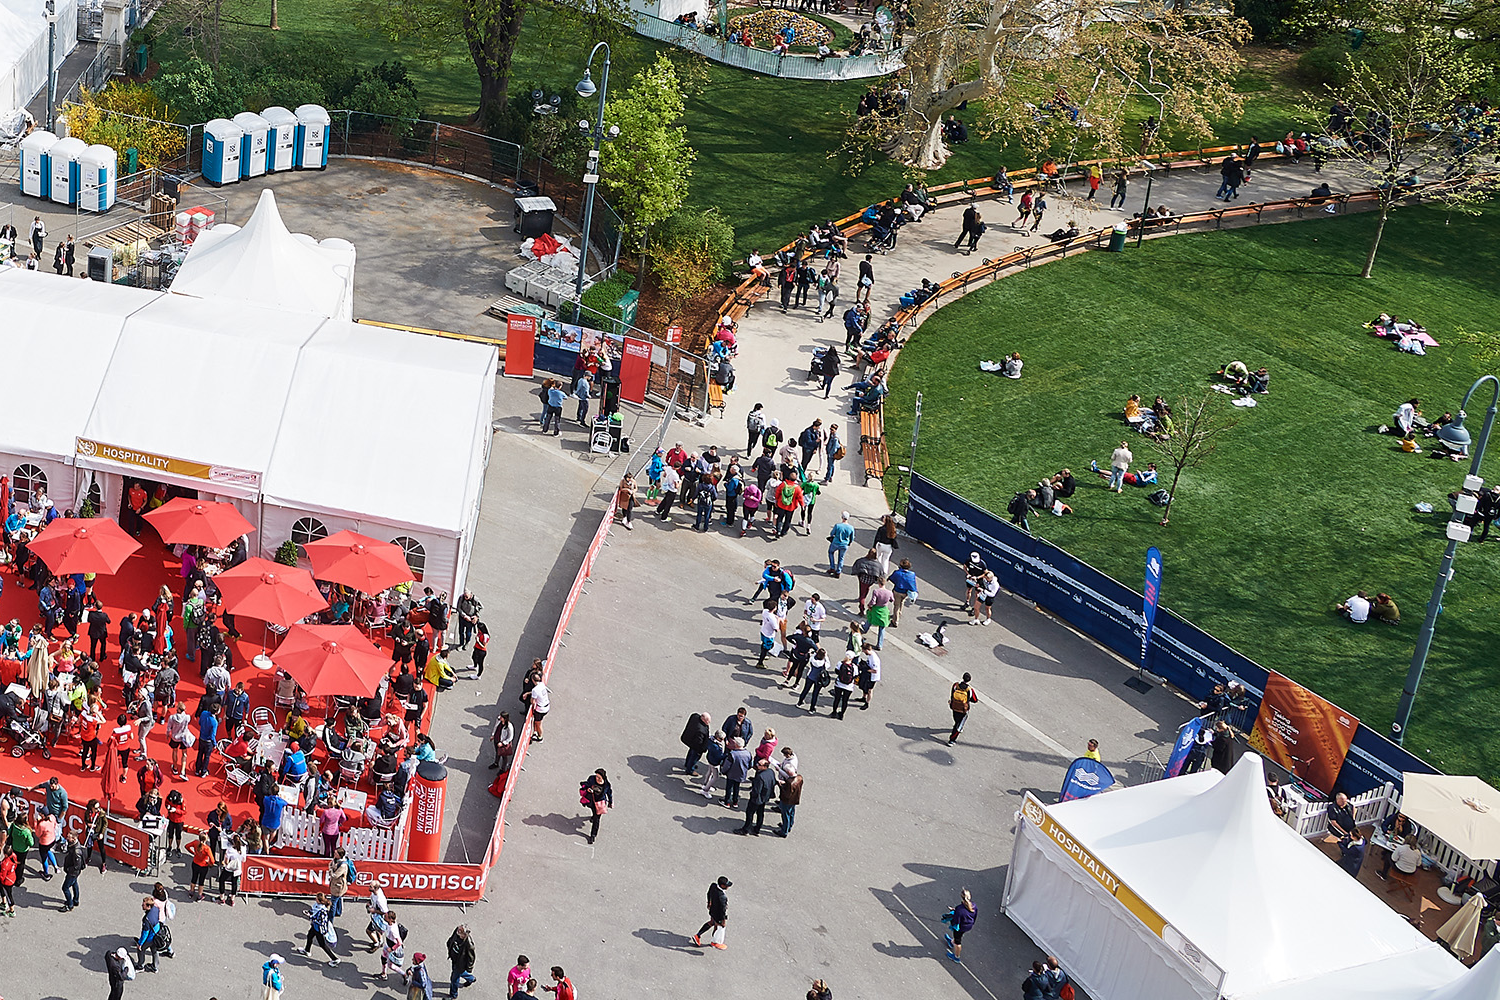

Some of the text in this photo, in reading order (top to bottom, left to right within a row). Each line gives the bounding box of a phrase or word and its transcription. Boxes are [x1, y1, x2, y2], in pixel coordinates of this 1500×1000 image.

[626, 343, 644, 351] WIENER
[103, 446, 169, 469] HOSPITALITY
[916, 508, 956, 535] VIENNA CITY MARATHON
[969, 539, 1012, 566] VIENNA CITY MARATHON
[1025, 569, 1071, 596] VIENNA CITY MARATHON
[1085, 601, 1131, 630] VIENNA CITY MARATHON
[1161, 646, 1171, 655] CITY
[1170, 651, 1193, 669] MARATHON
[1267, 724, 1279, 733] and
[1271, 719, 1292, 736] 1200°C
[1273, 710, 1291, 725] Taking
[1273, 715, 1299, 735] innovation
[1279, 729, 1297, 745] beyond
[1362, 767, 1373, 778] CITY
[416, 799, 428, 832] WIENER
[424, 787, 437, 835] STÄDTISCHE
[1049, 823, 1120, 891] HOSPITALITY
